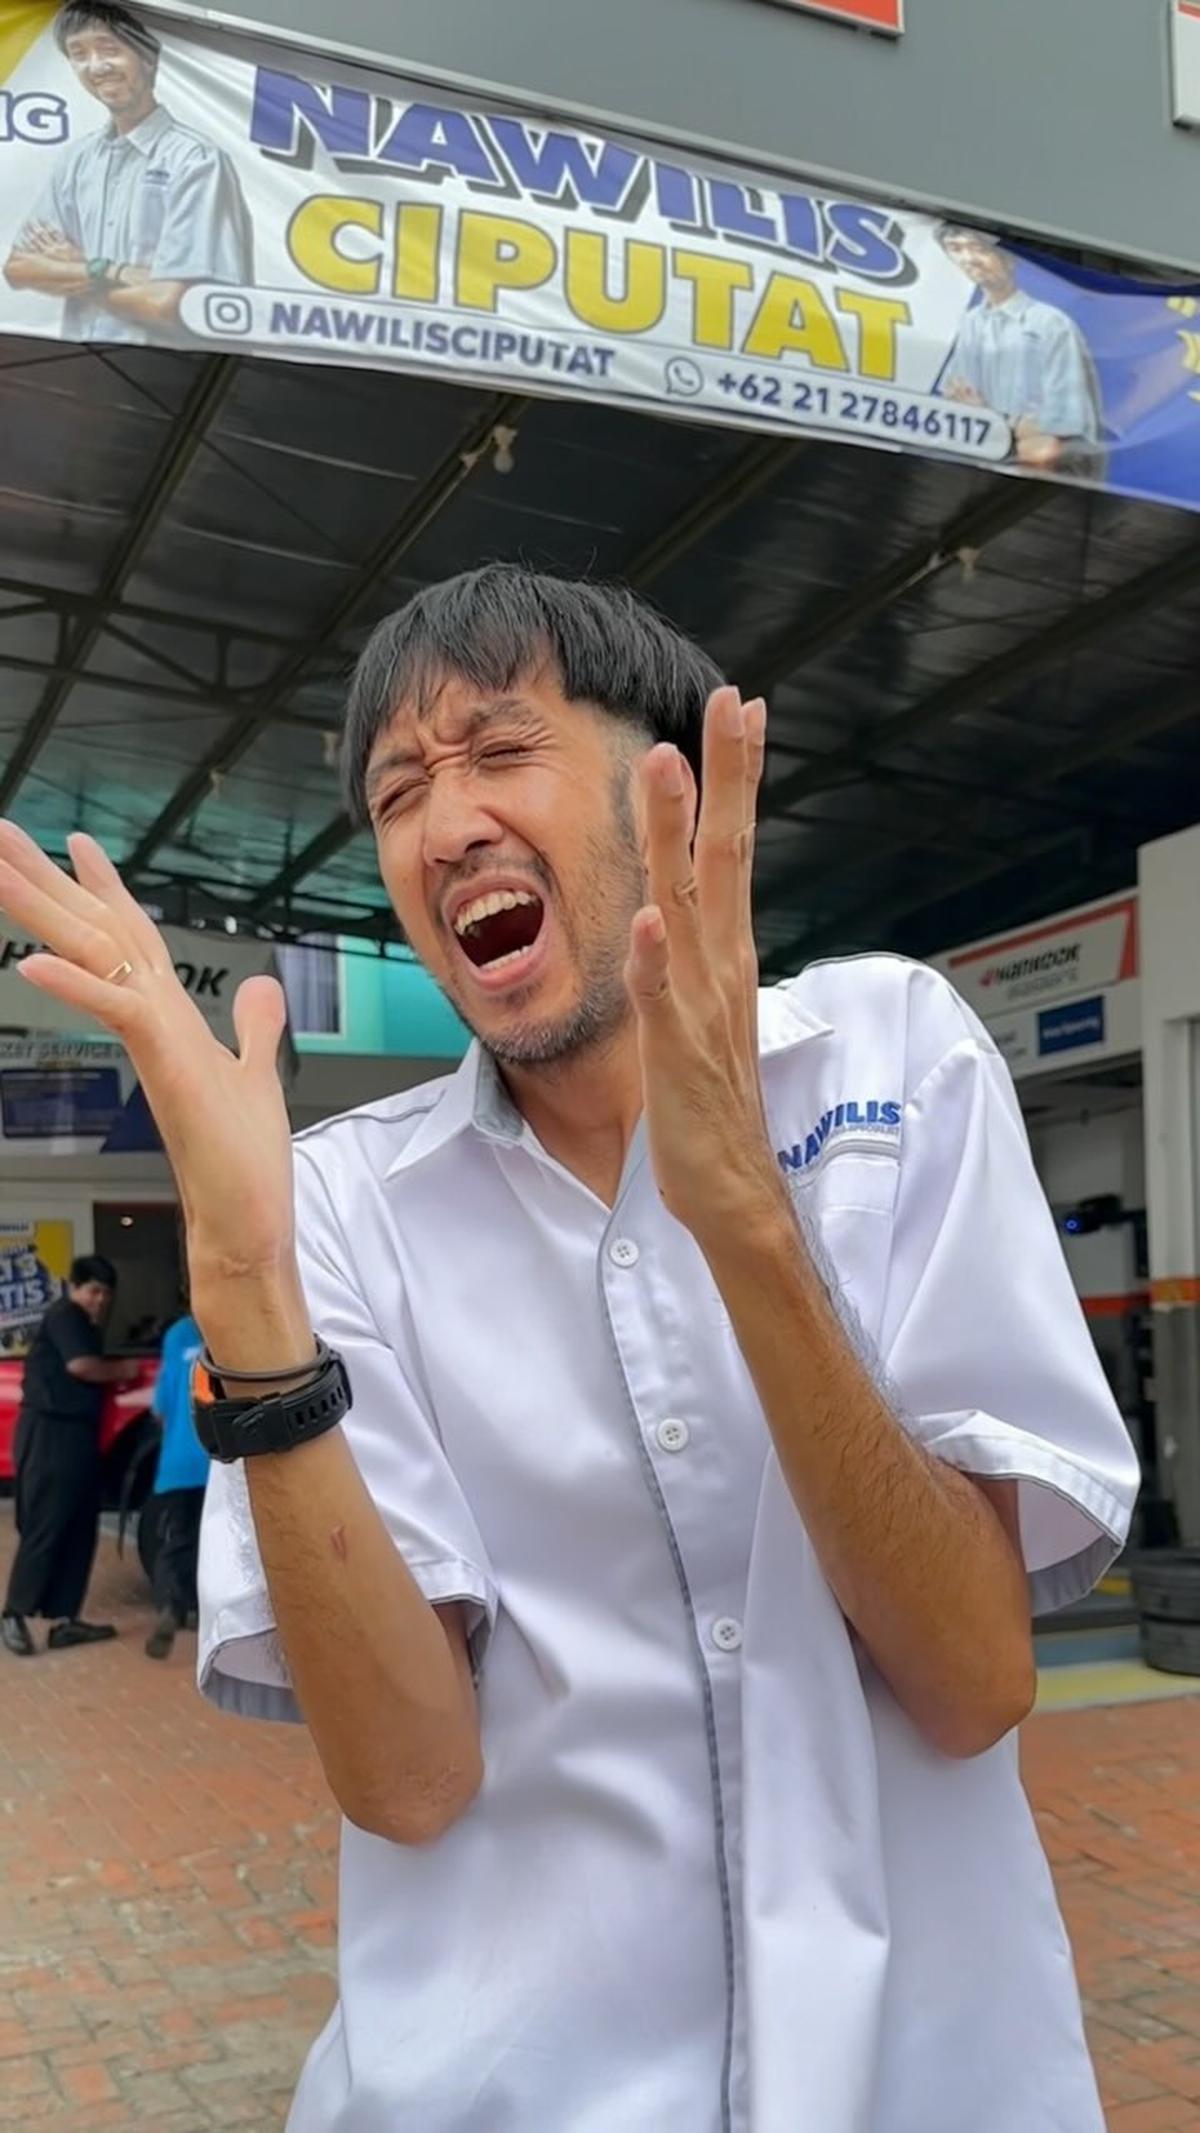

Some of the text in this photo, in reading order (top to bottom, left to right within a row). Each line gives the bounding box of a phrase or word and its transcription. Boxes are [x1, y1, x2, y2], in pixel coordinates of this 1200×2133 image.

[250, 66, 914, 282] NAWILIS
[286, 194, 912, 382] CIPUTAT
[269, 302, 615, 378] NAWILISCIPUTAT
[717, 371, 991, 447] +62 21 27846117
[777, 1101, 901, 1174] NAWILIS
